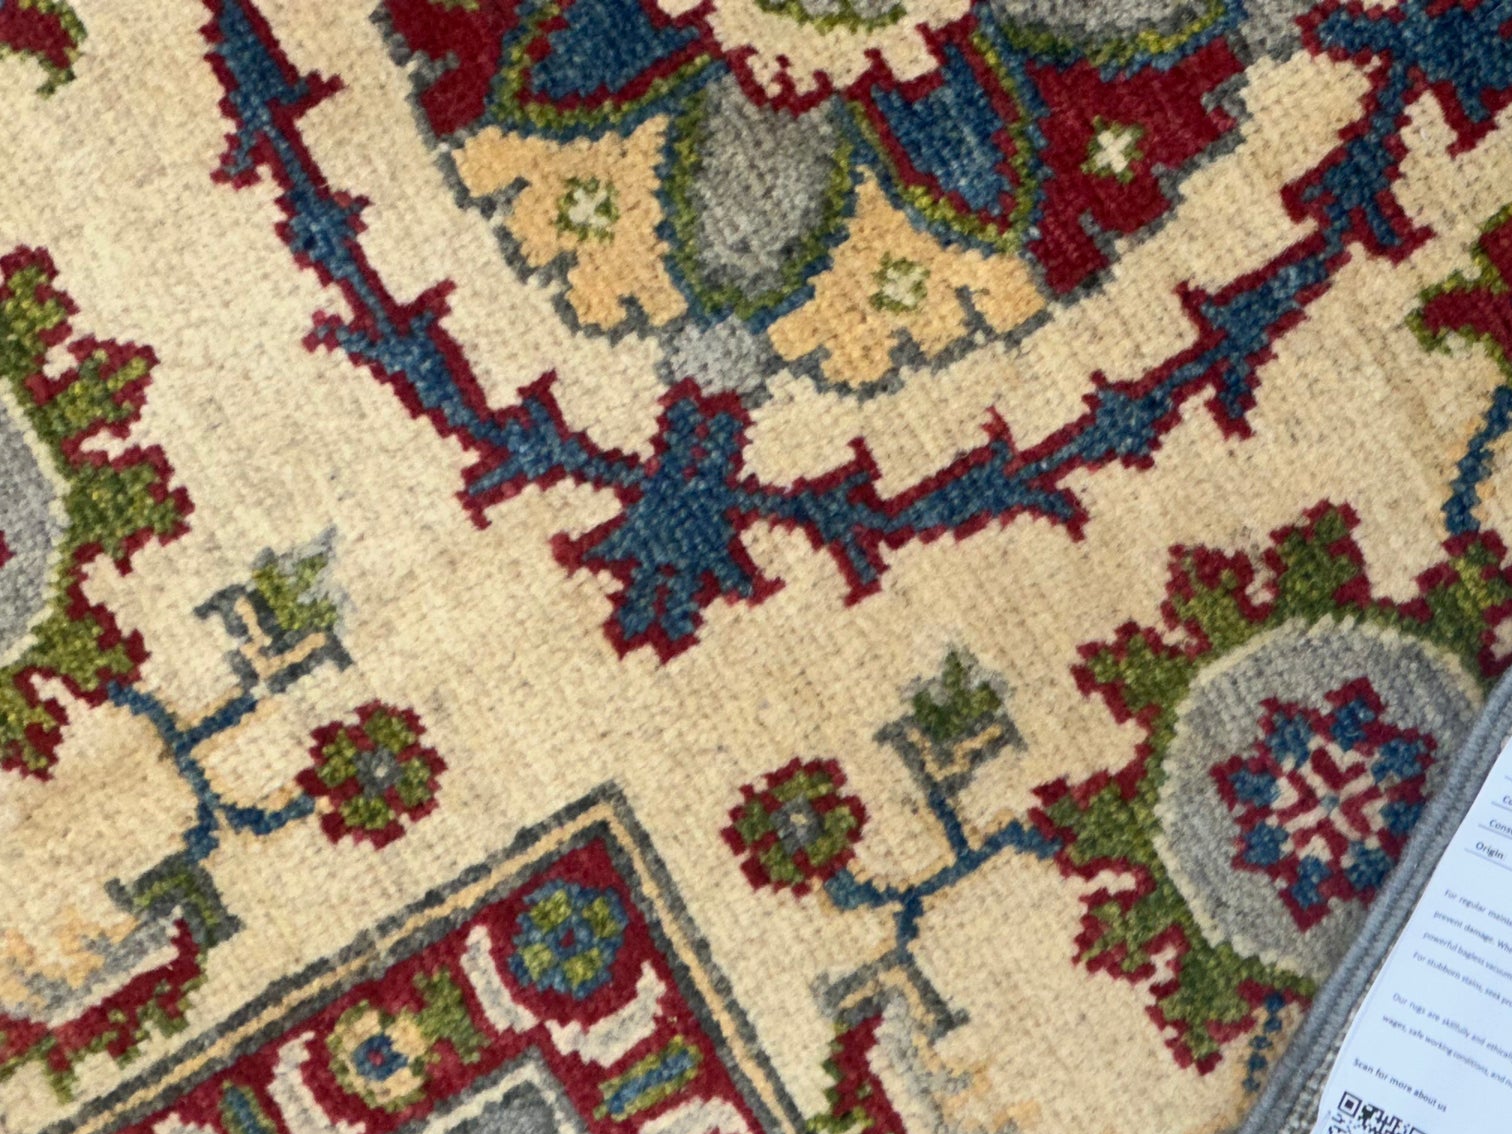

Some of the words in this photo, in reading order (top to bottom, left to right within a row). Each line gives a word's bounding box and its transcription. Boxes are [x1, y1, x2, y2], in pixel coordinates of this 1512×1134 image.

[1443, 888, 1457, 900] For
[1458, 895, 1486, 913] regular
[1432, 909, 1463, 929] prevent
[1462, 923, 1494, 944] damage.
[1422, 930, 1458, 952] powerful
[1456, 945, 1485, 966] bagless
[1392, 992, 1407, 1005] Our
[1408, 1001, 1426, 1015] rugs
[1426, 1010, 1440, 1022] are
[1441, 1017, 1471, 1038] skillfully
[1470, 1032, 1486, 1046] and
[1352, 1057, 1374, 1074] Scan
[1374, 1067, 1389, 1080] for
[1388, 1075, 1412, 1093] more
[1412, 1087, 1437, 1106] about
[1436, 1102, 1447, 1112] us
